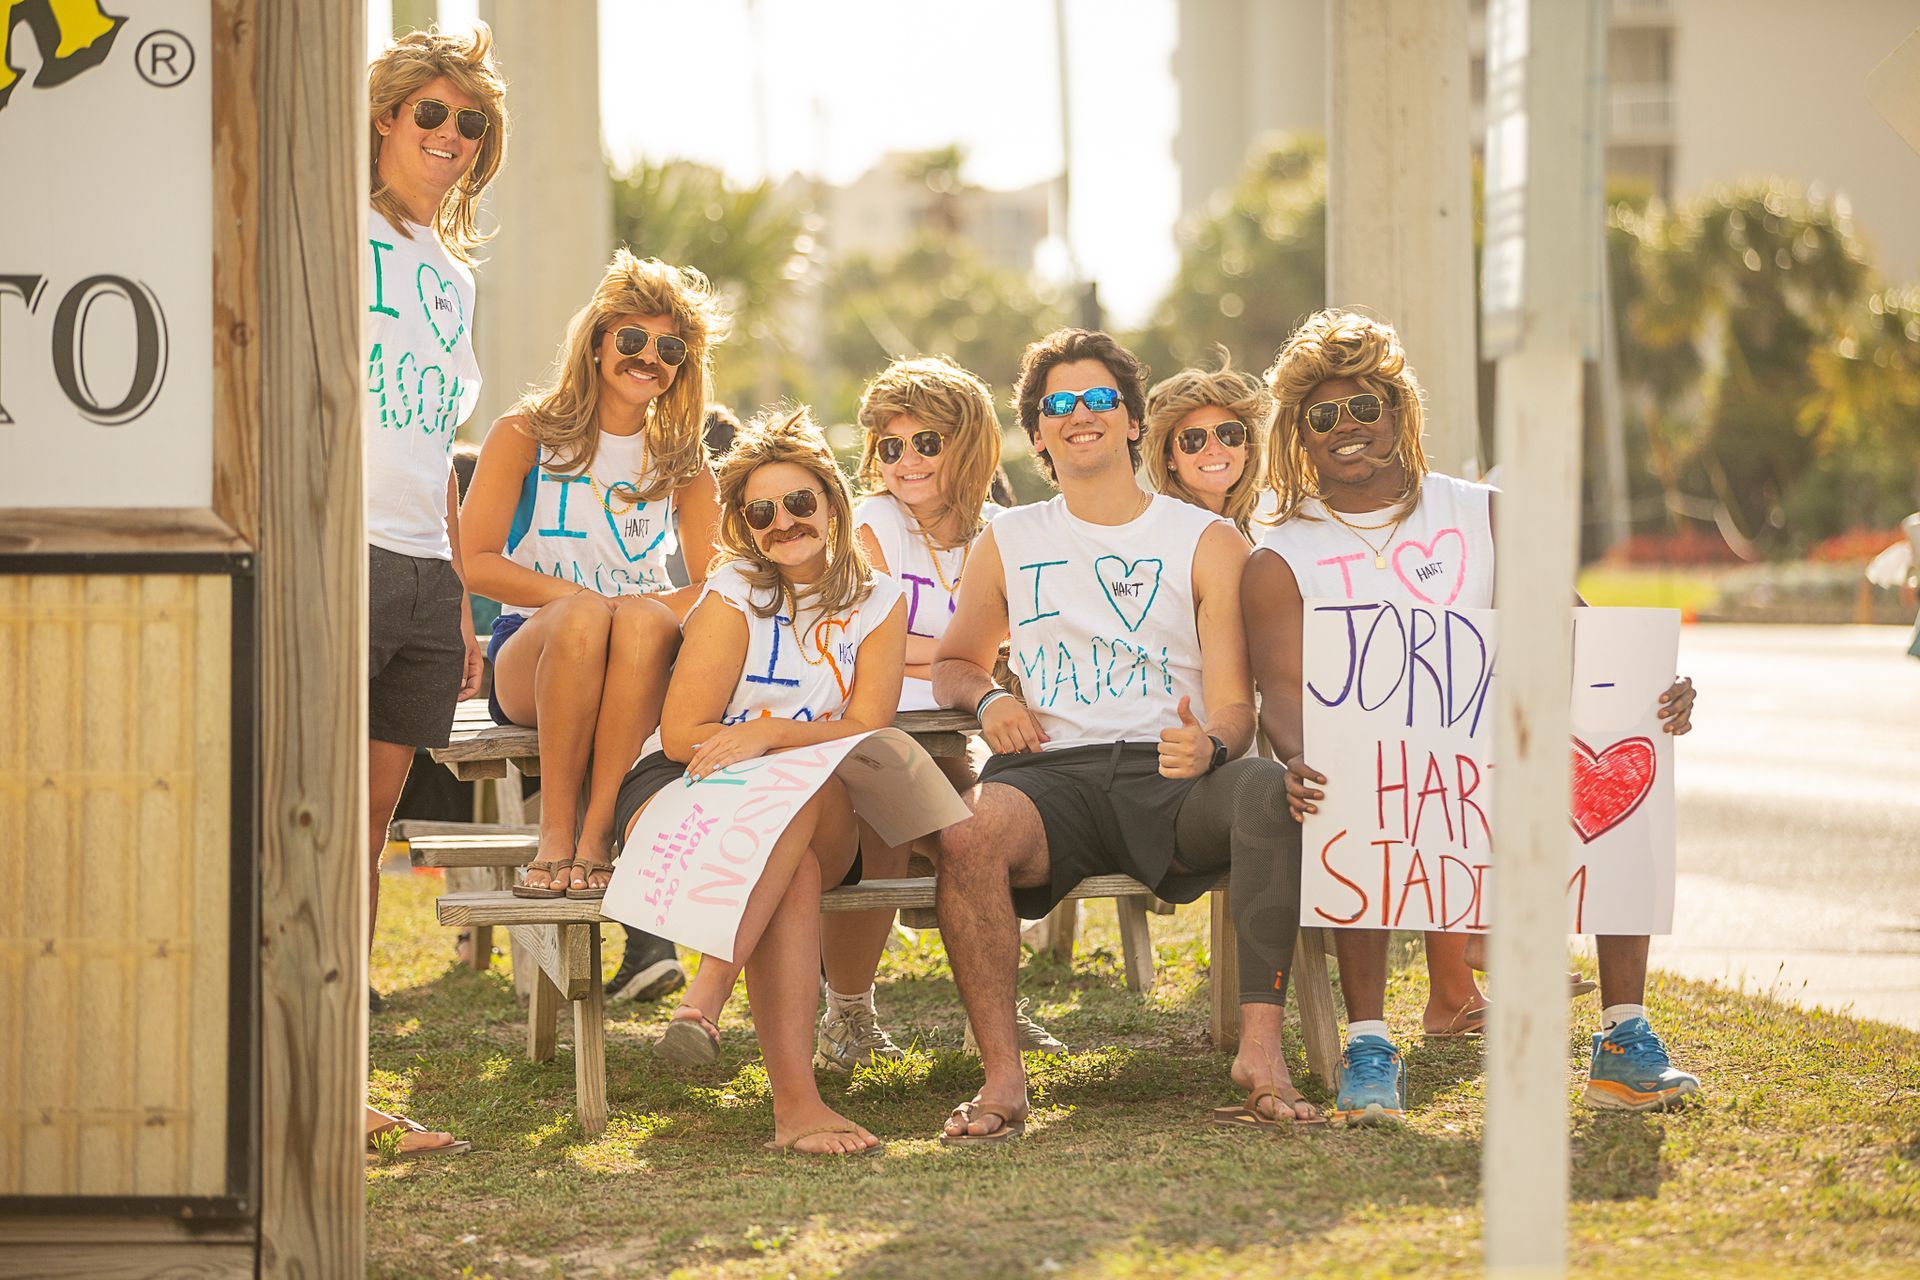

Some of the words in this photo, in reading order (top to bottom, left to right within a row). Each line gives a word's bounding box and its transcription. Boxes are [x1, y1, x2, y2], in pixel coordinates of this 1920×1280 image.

[538, 474, 591, 539] I
[624, 518, 650, 538] HART
[1019, 560, 1068, 626] I
[1112, 582, 1144, 598] HART
[1416, 562, 1443, 582] HART
[746, 615, 800, 687] I
[1376, 741, 1498, 853] HAR
[1314, 830, 1587, 934] STADI
